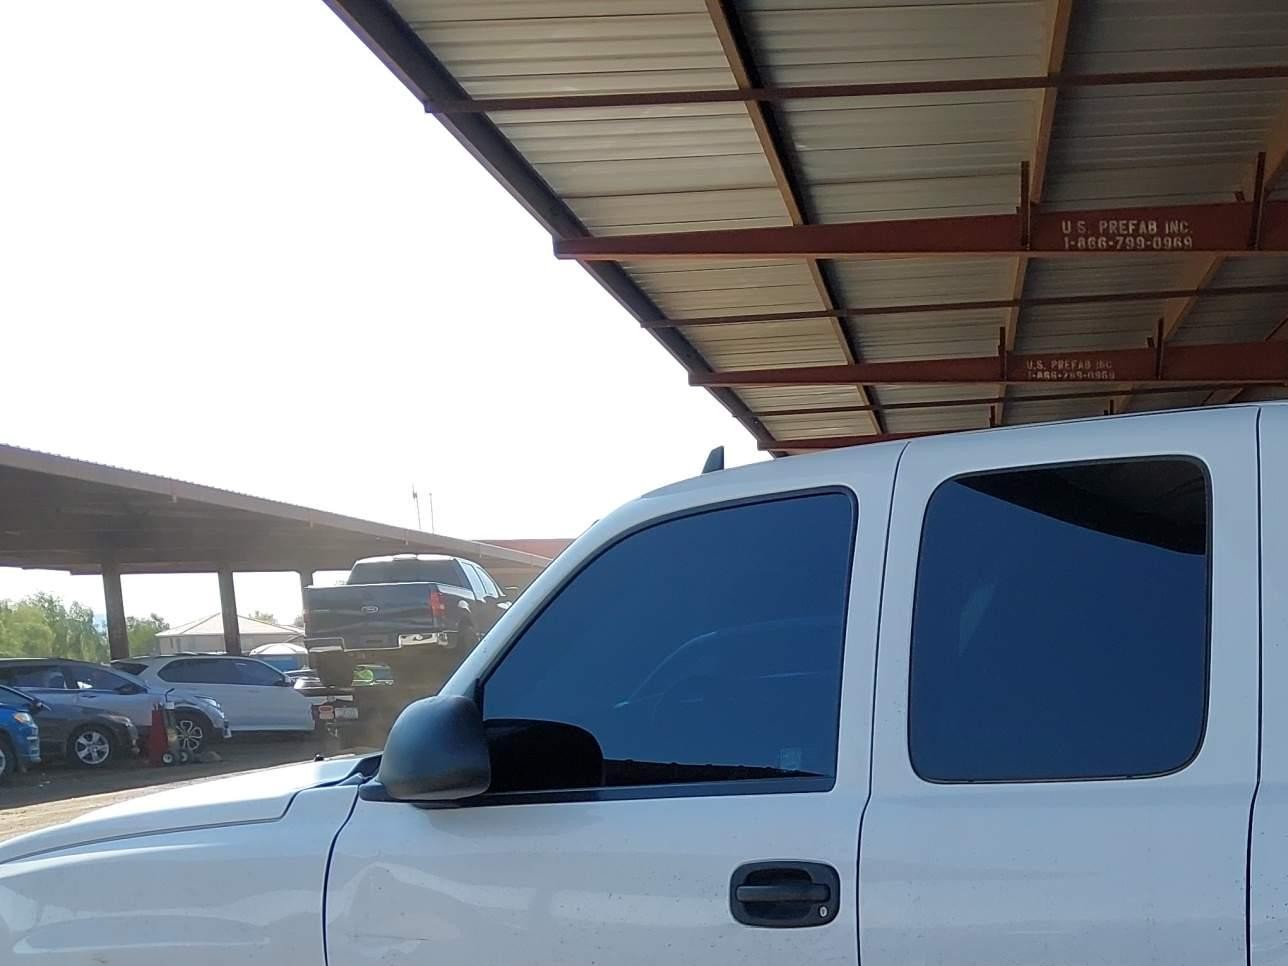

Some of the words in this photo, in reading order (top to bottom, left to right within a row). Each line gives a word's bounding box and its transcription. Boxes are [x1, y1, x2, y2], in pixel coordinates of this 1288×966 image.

[1099, 220, 1158, 234] PREFAB
[1165, 220, 1193, 234] INC.
[1063, 236, 1193, 250] 1-866-799-0969
[1026, 359, 1046, 370] U.S.
